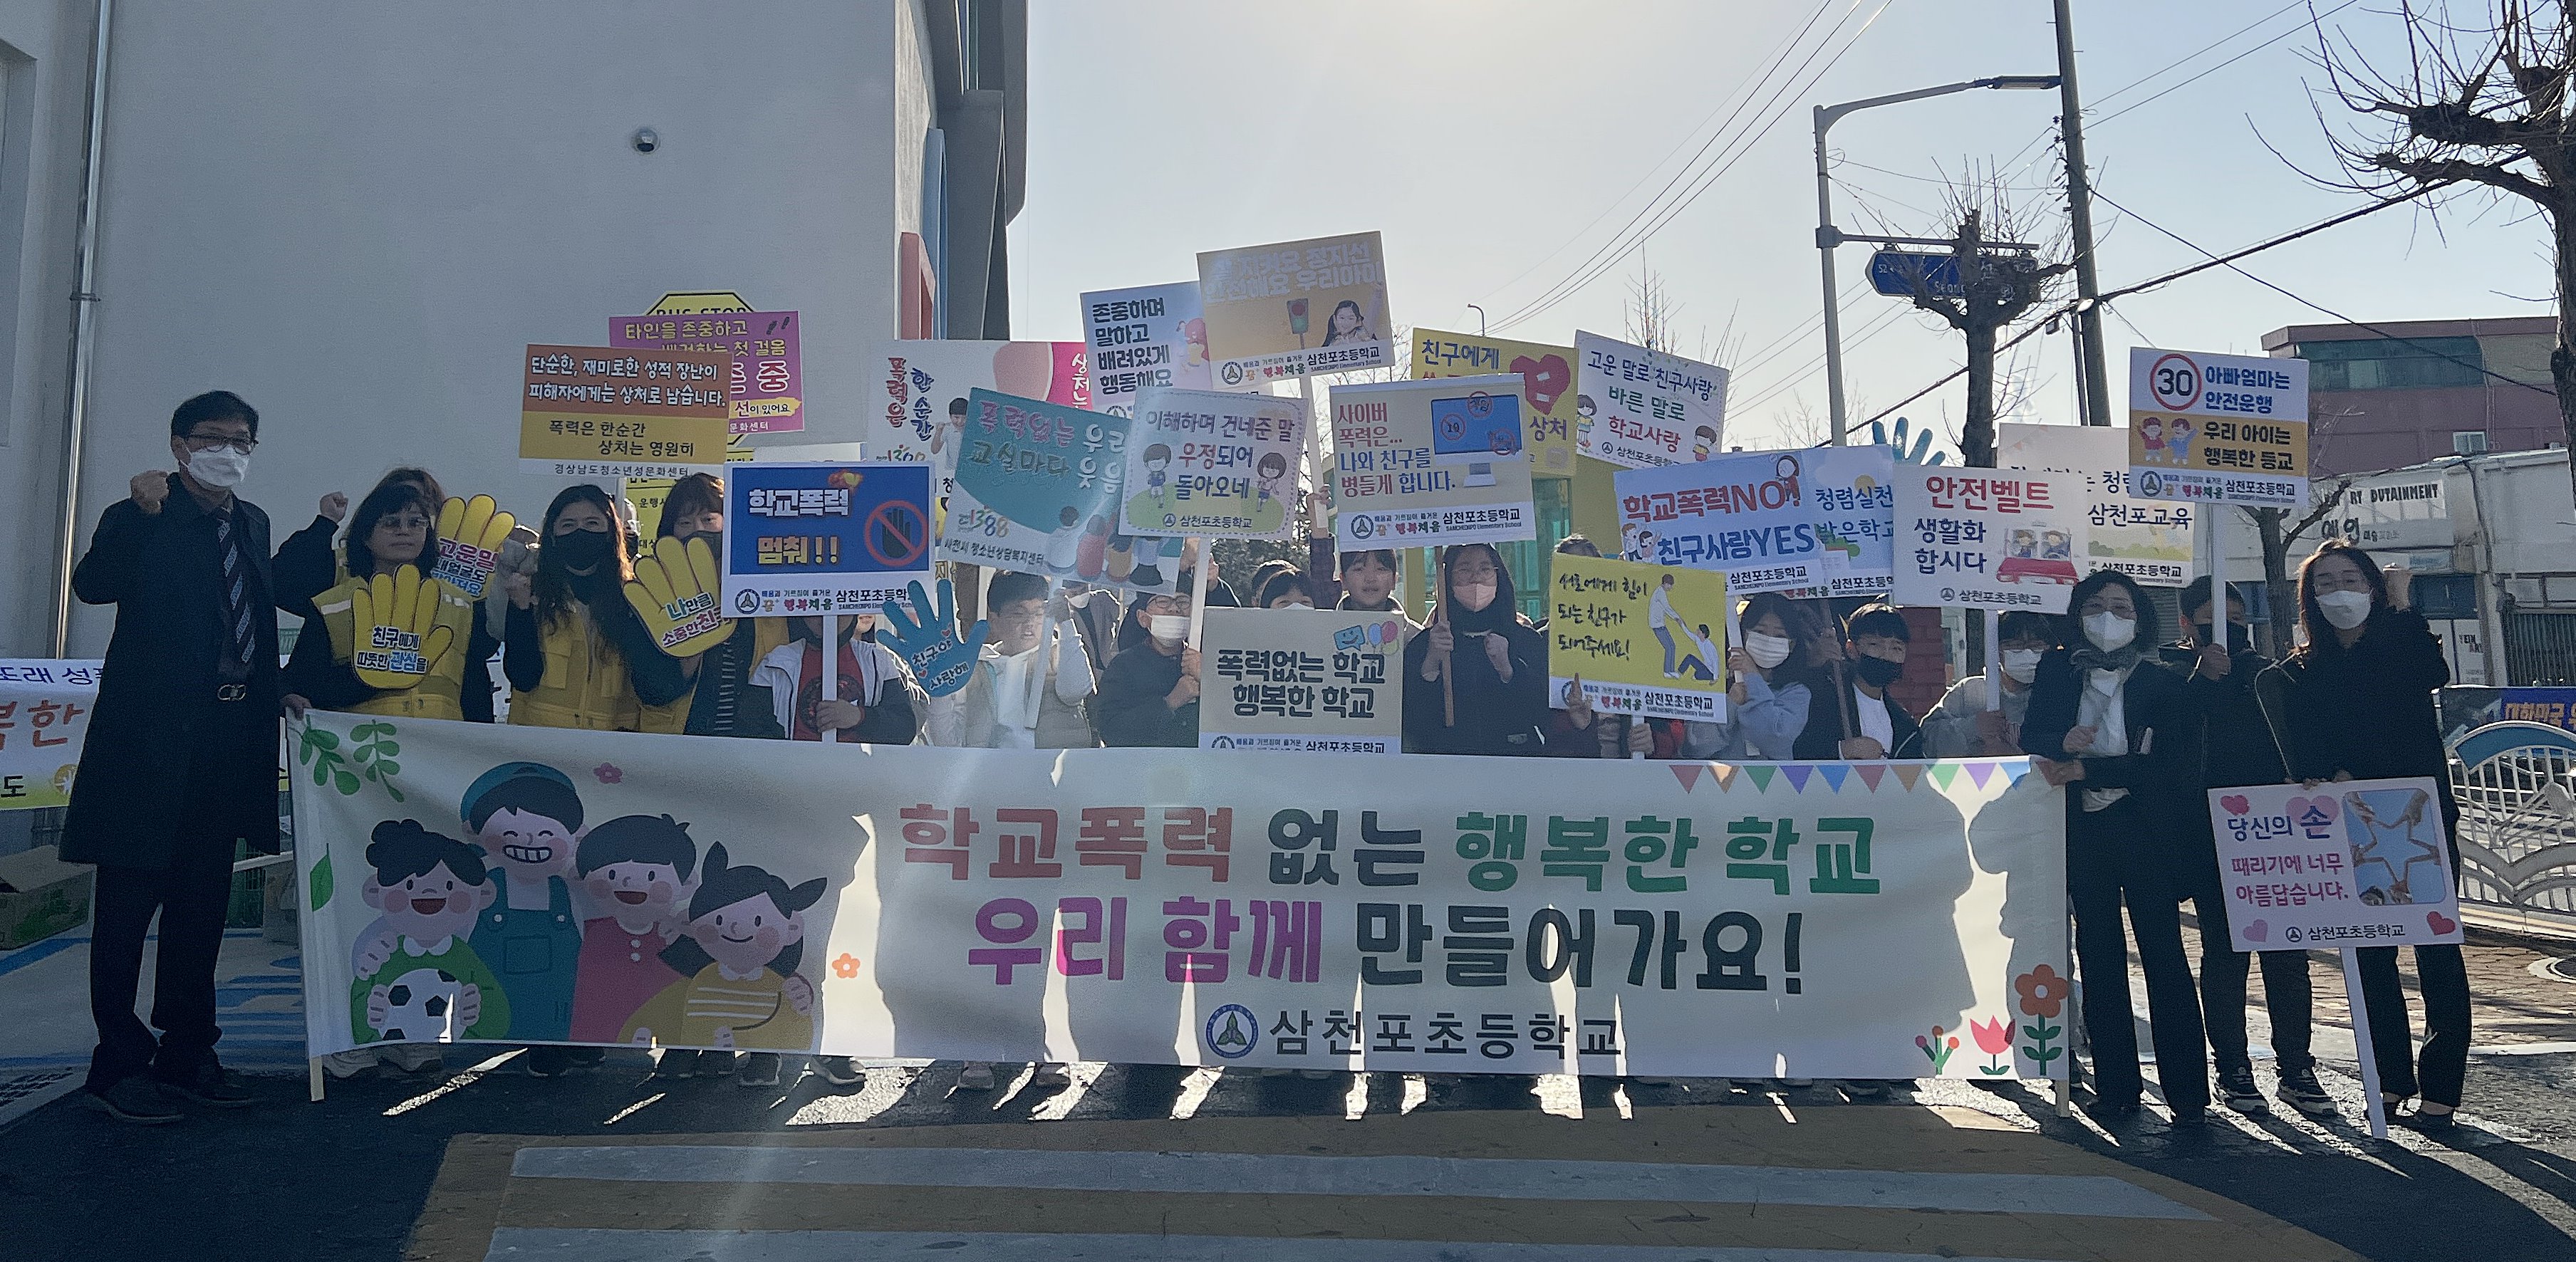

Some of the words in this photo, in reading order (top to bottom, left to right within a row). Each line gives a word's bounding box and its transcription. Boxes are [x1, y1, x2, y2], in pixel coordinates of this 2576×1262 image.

[1092, 297, 1165, 323] 존중하며
[625, 320, 676, 340] 타인을
[682, 320, 748, 338] 존중하고
[1095, 323, 1151, 348] 말하고
[734, 340, 749, 357] 첫
[754, 339, 785, 357] 걸음
[1098, 344, 1171, 370] 배려있게
[1307, 346, 1380, 366] 삼천포초등학교
[1421, 339, 1500, 370] 친구에게
[531, 353, 578, 377] 단순한,
[582, 358, 640, 378] 재미로한
[643, 360, 672, 380] 성적
[676, 362, 718, 381] 장난이
[1587, 350, 1617, 377] 고운
[1622, 359, 1651, 382] 말로
[1655, 367, 1713, 402] 친구사랑
[2205, 365, 2291, 390] 아빠엄마는
[529, 382, 616, 404] 피해자에게는
[619, 385, 663, 405] 상처로
[665, 384, 727, 407] 남습니다.
[886, 357, 908, 428] 폭력은
[1099, 369, 1173, 395] 행동해요
[2156, 367, 2194, 397] 30
[762, 403, 791, 415] 있어요
[1336, 402, 1388, 424] 사이버
[1609, 385, 1645, 414] 바른
[1651, 396, 1686, 422] 말로
[2205, 391, 2273, 414] 안전운행
[549, 420, 596, 437] 폭력은
[600, 421, 646, 439] 한순간
[977, 400, 1076, 448] 폭력없는
[1146, 410, 1215, 434] 이해하며
[1221, 414, 1272, 441] 건네준
[1278, 418, 1296, 442] 말
[1529, 415, 1567, 442] 상처
[1608, 414, 1682, 453] 학교사랑
[2203, 421, 2237, 442] 우리
[2241, 424, 2291, 445] 아이는
[597, 440, 644, 457] 상처는
[649, 441, 695, 458] 영원히
[1178, 442, 1254, 470] 우정되어
[1340, 450, 1374, 472] 나와
[1380, 447, 1431, 471] 친구를
[1616, 446, 1681, 467] 삼천포초등학
[2203, 447, 2255, 468] 행복한
[2260, 451, 2294, 471] 등교
[554, 464, 690, 478] 경상남도청소년성문화센터
[967, 439, 1071, 479] 교실마다
[1078, 457, 1123, 494] 웃음
[1174, 474, 1250, 501] 돌아오네
[1341, 474, 1393, 498] 병들게
[1398, 470, 1455, 494] 합니다.
[1926, 475, 2055, 513] 안전벨트
[2225, 479, 2296, 497] 삼천포초등학교
[749, 488, 850, 517] 학교폭력
[1815, 484, 1894, 511] 청렴실천
[1179, 515, 1252, 528] 삼천포초등학교
[1443, 508, 1520, 524] 삼천포초등학교
[2088, 502, 2193, 530] 삼천포교육
[1657, 523, 1816, 567] 친구사랑YES
[1914, 518, 1988, 546] 생활화
[1914, 548, 1988, 575] 합시다
[1559, 573, 1617, 593] 서로에게
[1622, 577, 1648, 600] 힘이
[1730, 566, 1807, 584] 삼천포초등학교
[666, 593, 712, 620] 나만큼
[836, 588, 911, 603] 삼천포초등학
[1959, 588, 2042, 606] 삼천포초등학교
[1558, 603, 1584, 624] 되는
[1587, 603, 1628, 628] 친구가
[373, 626, 420, 650] 친구에게
[1558, 635, 1630, 661] 되어주세요!
[912, 640, 953, 668] 친구야
[1217, 649, 1324, 683] 폭력없는
[1332, 652, 1386, 684] 학교
[930, 662, 970, 690] 사랑해
[1233, 684, 1315, 718] 행복한
[1321, 686, 1375, 719] 학교
[1644, 692, 1713, 711] 삼천포초등학교
[2228, 815, 2293, 842] 당신의
[2300, 805, 2332, 840] 손
[900, 803, 1233, 883] 학교폭력
[1268, 808, 1425, 887] 없는
[1455, 812, 1699, 893] 행복한
[1725, 816, 1881, 896] 학교
[2231, 854, 2302, 876] 때리기에
[2307, 852, 2344, 875] 너무
[2235, 881, 2349, 907] 아름답습니다.
[968, 897, 1128, 985] 우리
[1163, 895, 1323, 984] 함께
[1356, 902, 1804, 996] 만들어가요!
[2307, 924, 2406, 943] 삼천포초등학교
[1270, 1008, 1621, 1060] 삼천포초등학교
